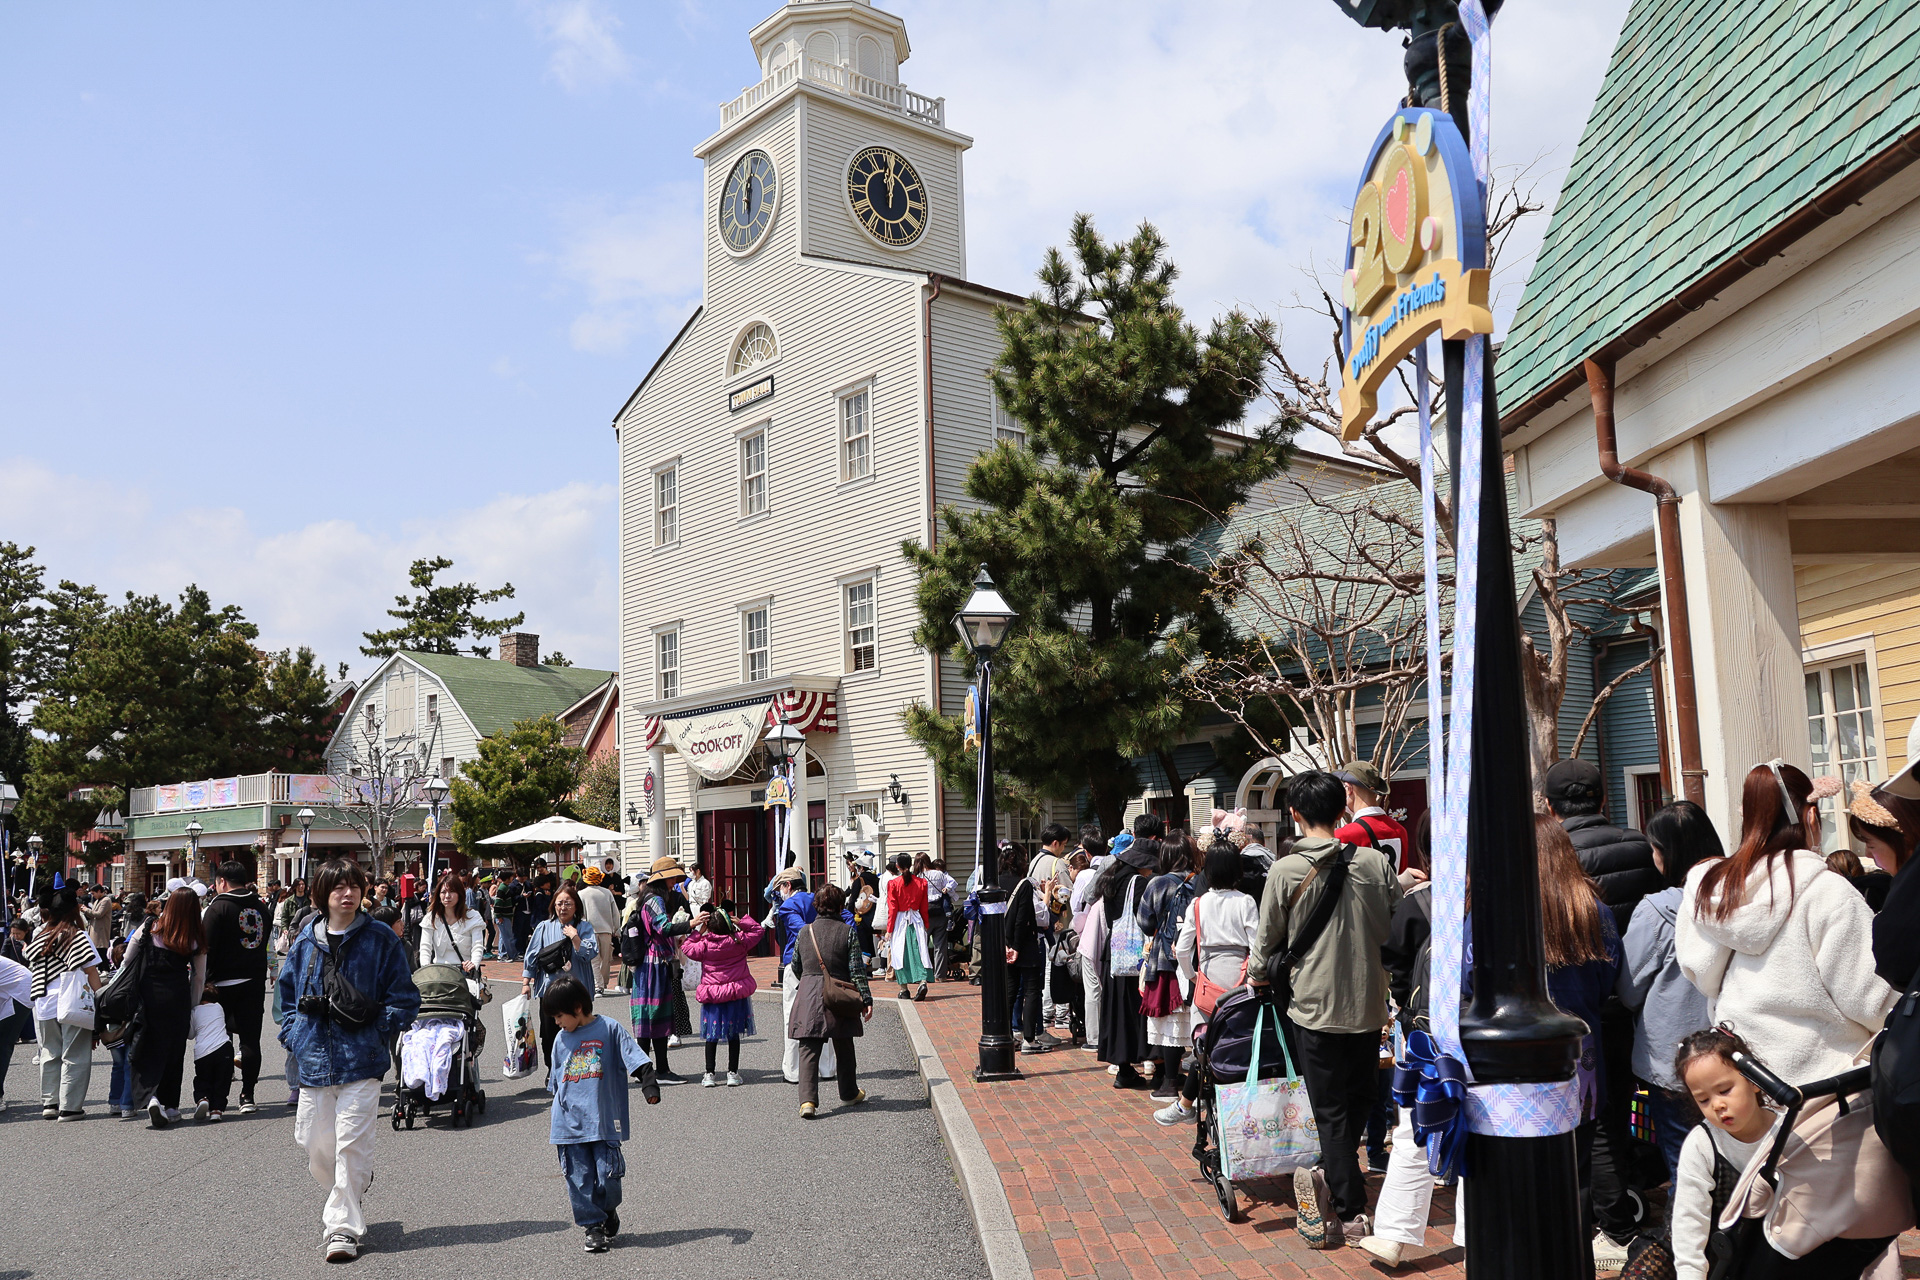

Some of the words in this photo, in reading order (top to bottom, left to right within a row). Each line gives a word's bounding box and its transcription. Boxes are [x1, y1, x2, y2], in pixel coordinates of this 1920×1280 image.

[1351, 324, 1380, 380] Duffy
[1380, 305, 1398, 337] and
[1397, 272, 1446, 320] Friends
[690, 734, 743, 755] COOK-OFF
[238, 907, 264, 949] 9
